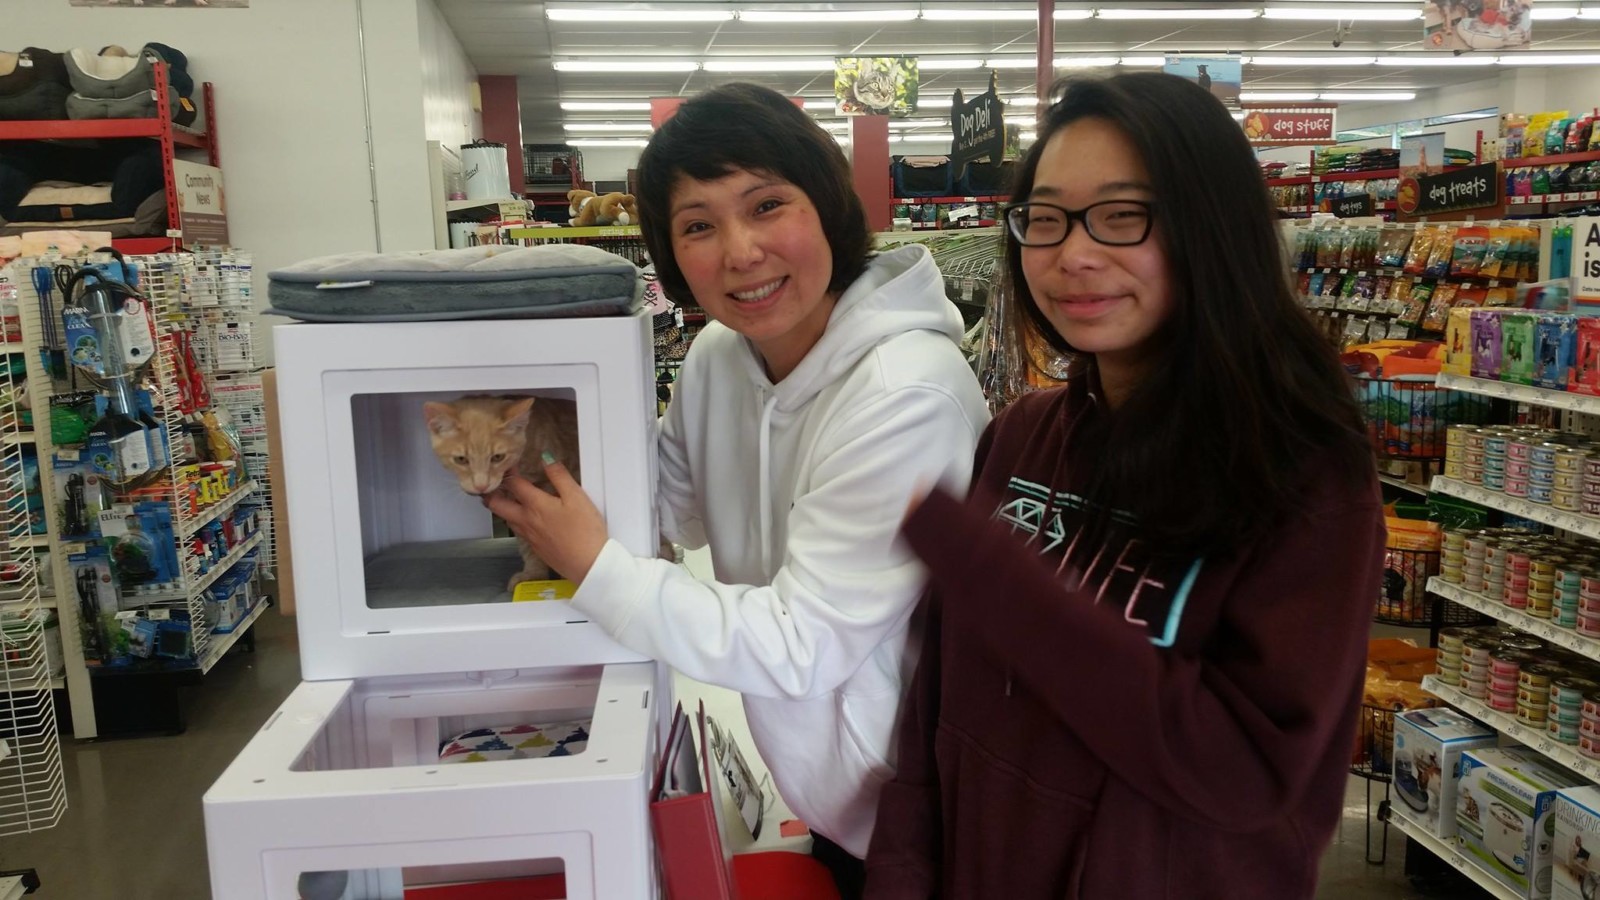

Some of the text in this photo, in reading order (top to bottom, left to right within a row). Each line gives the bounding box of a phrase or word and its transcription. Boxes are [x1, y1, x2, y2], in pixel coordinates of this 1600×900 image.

[960, 113, 974, 147] Dog
[975, 98, 991, 131] Deli
[1273, 118, 1330, 135] dog stuff
[185, 173, 214, 190] Community
[1429, 176, 1487, 204] dog treats
[196, 191, 211, 205] News
[1339, 201, 1363, 215] dog toys
